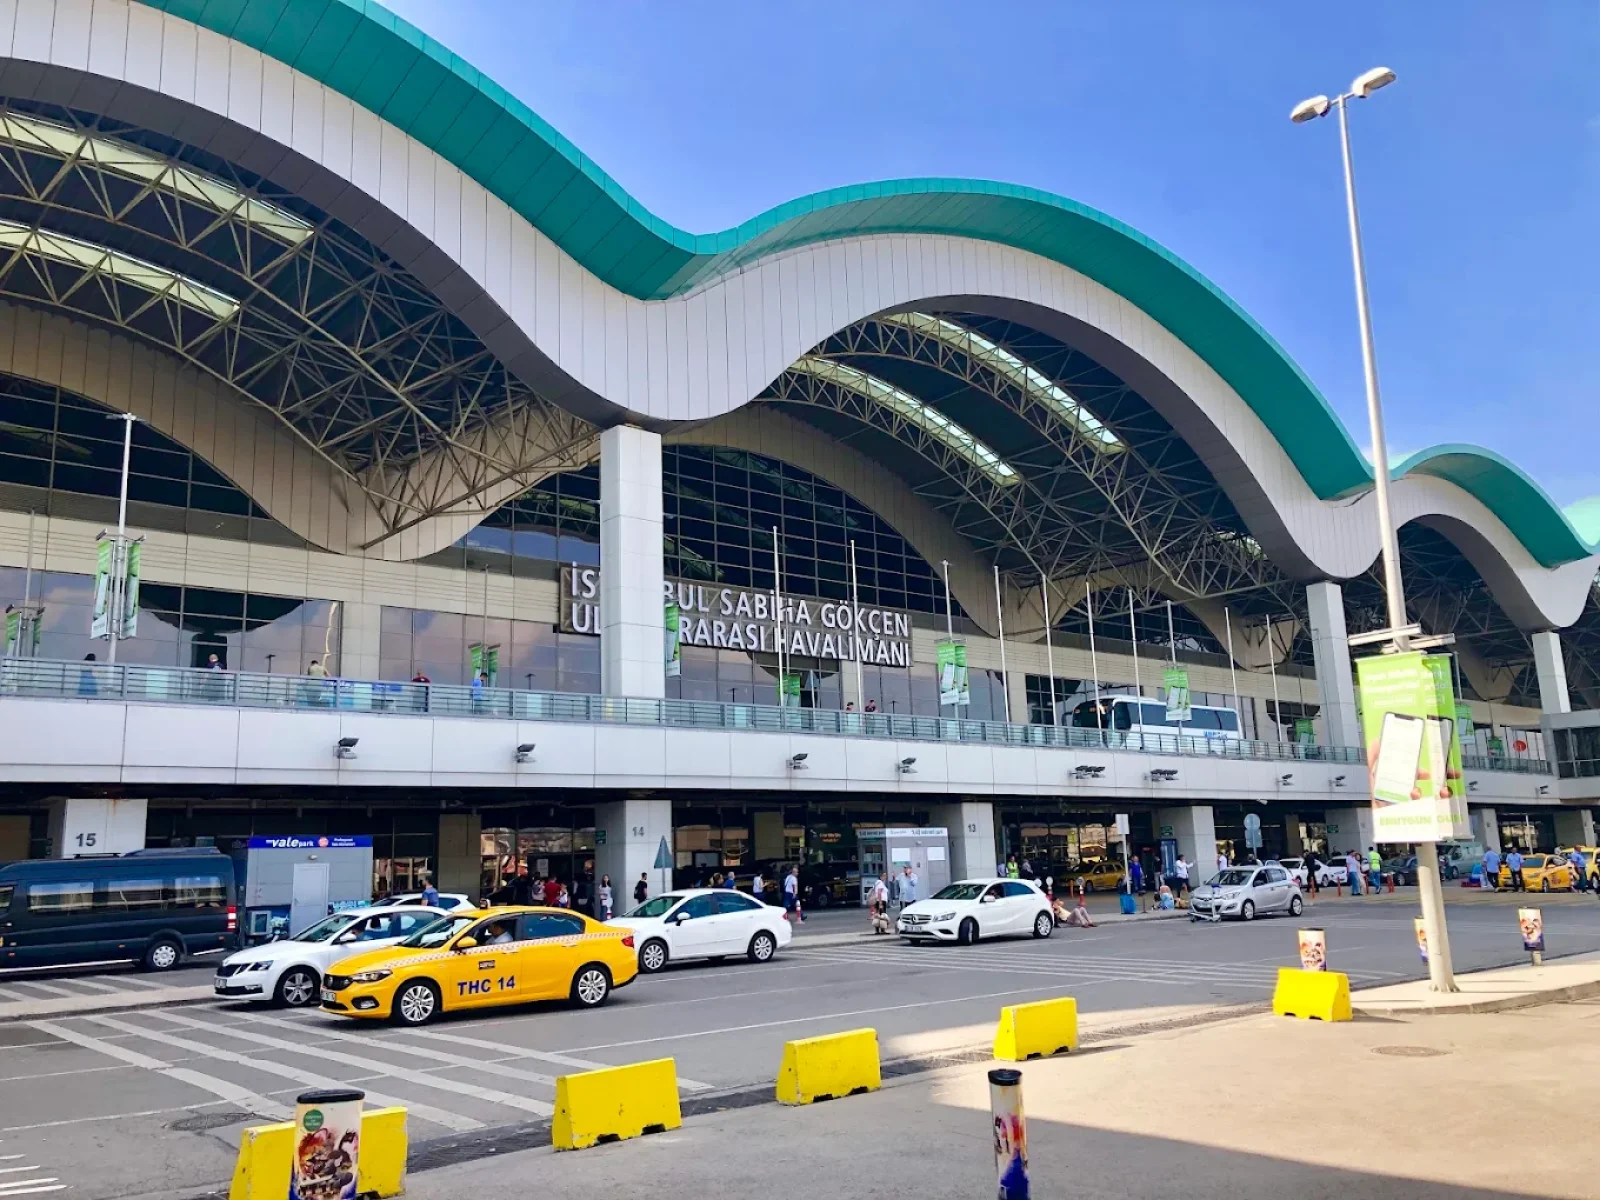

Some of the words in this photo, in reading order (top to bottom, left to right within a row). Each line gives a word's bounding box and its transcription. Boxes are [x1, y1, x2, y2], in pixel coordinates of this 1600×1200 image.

[571, 561, 710, 612] İSBUL
[720, 588, 812, 625] SABİHA
[820, 600, 909, 640] GÖKÇEN
[571, 602, 765, 651] ULRARASI
[773, 627, 911, 667] HAVALİMANI
[632, 826, 646, 837] 14
[967, 823, 977, 833] 13
[75, 832, 97, 848] 15
[457, 978, 492, 996] THC
[497, 974, 516, 991] 14
